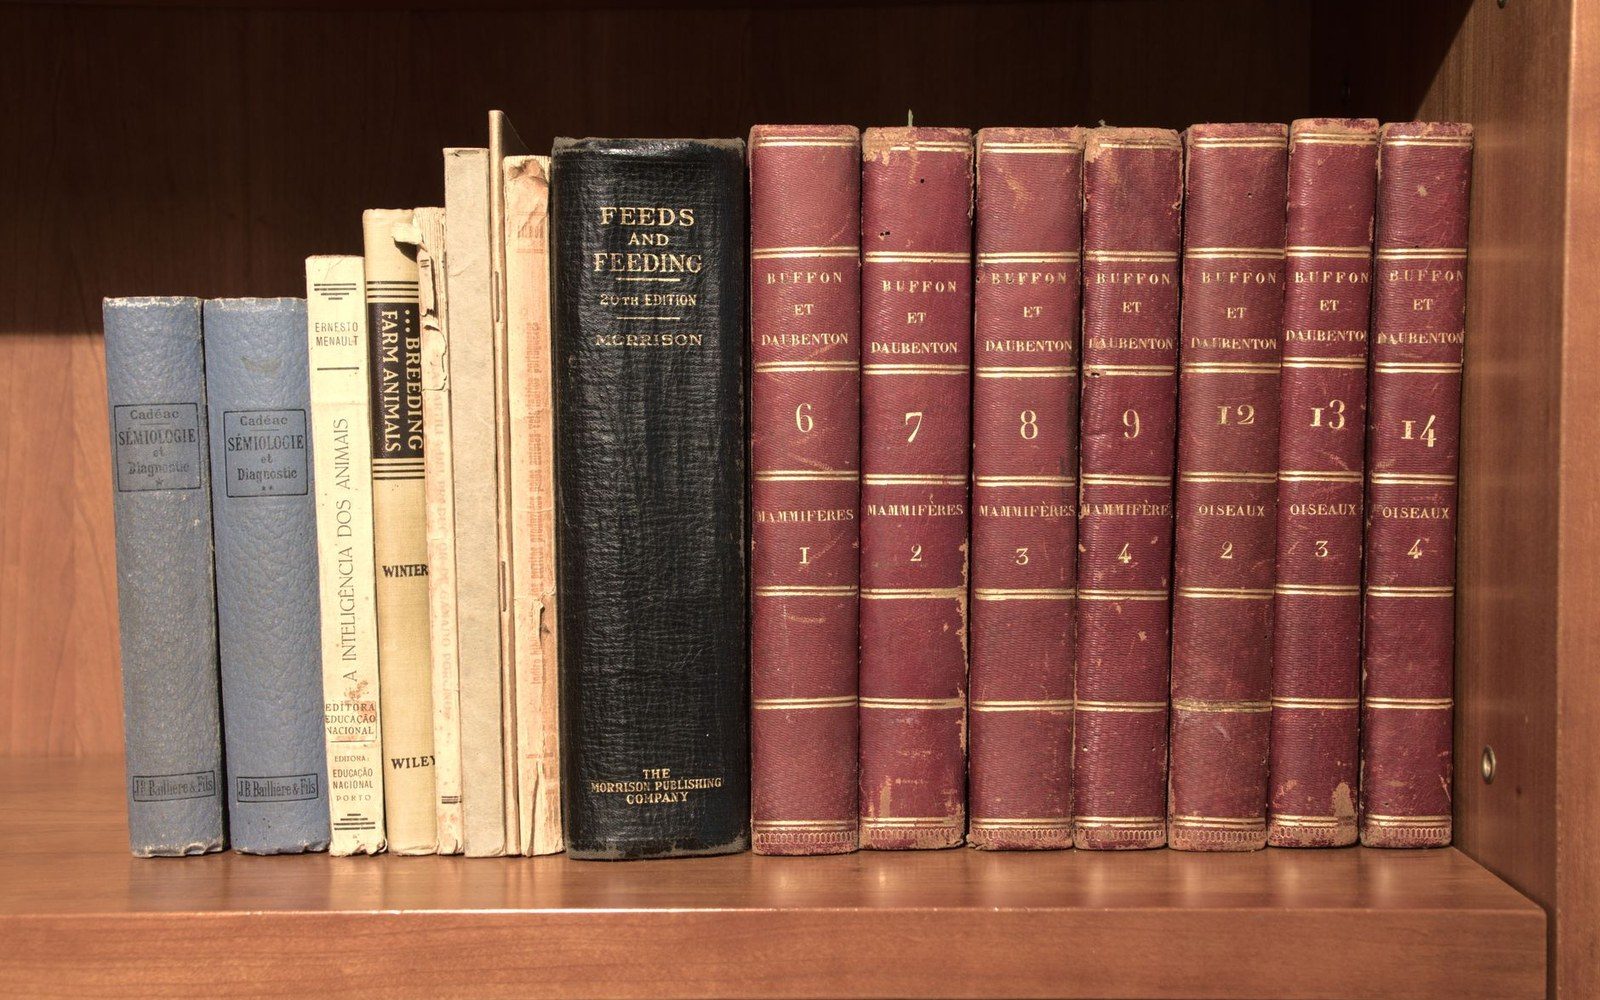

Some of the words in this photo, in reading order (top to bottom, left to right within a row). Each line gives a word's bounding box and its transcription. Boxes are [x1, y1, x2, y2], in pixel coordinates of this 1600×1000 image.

[600, 206, 695, 226] FEEDS
[628, 232, 669, 246] AND
[593, 253, 702, 273] FEEDING
[767, 272, 842, 284] BUFFON
[992, 273, 1067, 285] BUFFON
[1096, 273, 1170, 284] BUFFON
[1201, 272, 1276, 284] BUFFON
[1294, 271, 1369, 284] BUFFON
[1389, 270, 1463, 282] BUFFON
[882, 280, 957, 293] BUFFON
[600, 294, 639, 306] 20TH
[645, 294, 697, 306] EDITION
[1320, 299, 1339, 311] ET
[1413, 299, 1433, 310] ET
[794, 304, 814, 316] ET
[1023, 306, 1043, 318] ET
[1122, 302, 1142, 313] ET
[1226, 307, 1246, 319] ET
[907, 312, 926, 324] ET
[315, 322, 359, 333] ERNESTO
[316, 335, 359, 347] MENAULT
[381, 310, 399, 363] FARM
[595, 334, 703, 346] MORRISON
[762, 333, 848, 346] DAUBENTON
[871, 341, 958, 354] DAUBENTON
[985, 340, 1073, 352] DAUBENTON
[1089, 338, 1173, 350] DAUBENTON
[1190, 337, 1277, 350] DAUBENTON
[405, 337, 423, 451] BREEDING
[130, 409, 180, 420] Cadéac
[382, 367, 401, 452] ANIMALS
[1217, 404, 1255, 426] 12
[1310, 400, 1345, 429] 13
[240, 416, 289, 426] Cadéac
[795, 403, 813, 432] 6
[1122, 409, 1140, 438] 9
[905, 412, 923, 443] 7
[1020, 410, 1038, 440] 8
[1401, 415, 1437, 447] 14
[118, 427, 197, 446] SÉMIOLOGIE
[228, 434, 305, 451] SÉMIOLOGIE
[153, 446, 165, 457] et
[261, 453, 273, 463] et
[333, 418, 351, 490] ANIMAIS
[237, 467, 298, 482] Diagnostic
[867, 500, 964, 515] MAMMIFÈRES
[980, 502, 1075, 516] MAMMIFÈRES
[1198, 504, 1265, 516] OISEAUX
[1289, 504, 1356, 516] OISEAUX
[1382, 506, 1449, 519] OISEAUX
[336, 499, 353, 538] DOS
[910, 544, 922, 561] 2
[1118, 543, 1132, 563] 4
[1220, 541, 1233, 559] 2
[1314, 540, 1328, 558] 3
[1407, 539, 1422, 559] 4
[1016, 548, 1029, 565] 3
[382, 564, 429, 577] WINTER
[337, 546, 357, 661] INTELIGÊNCIA
[342, 670, 358, 682] A
[325, 703, 375, 711] EDITORA
[325, 713, 376, 724] EDUCAÇÃO
[332, 767, 373, 777] EDUCAÇÃO
[642, 768, 671, 779] THE
[292, 783, 300, 795] &
[300, 778, 316, 795] Fils
[333, 780, 373, 789] NACIONAL
[591, 781, 650, 793] MORRISON
[655, 777, 722, 791] PUBLISHING
[626, 791, 688, 804] COMPANY
